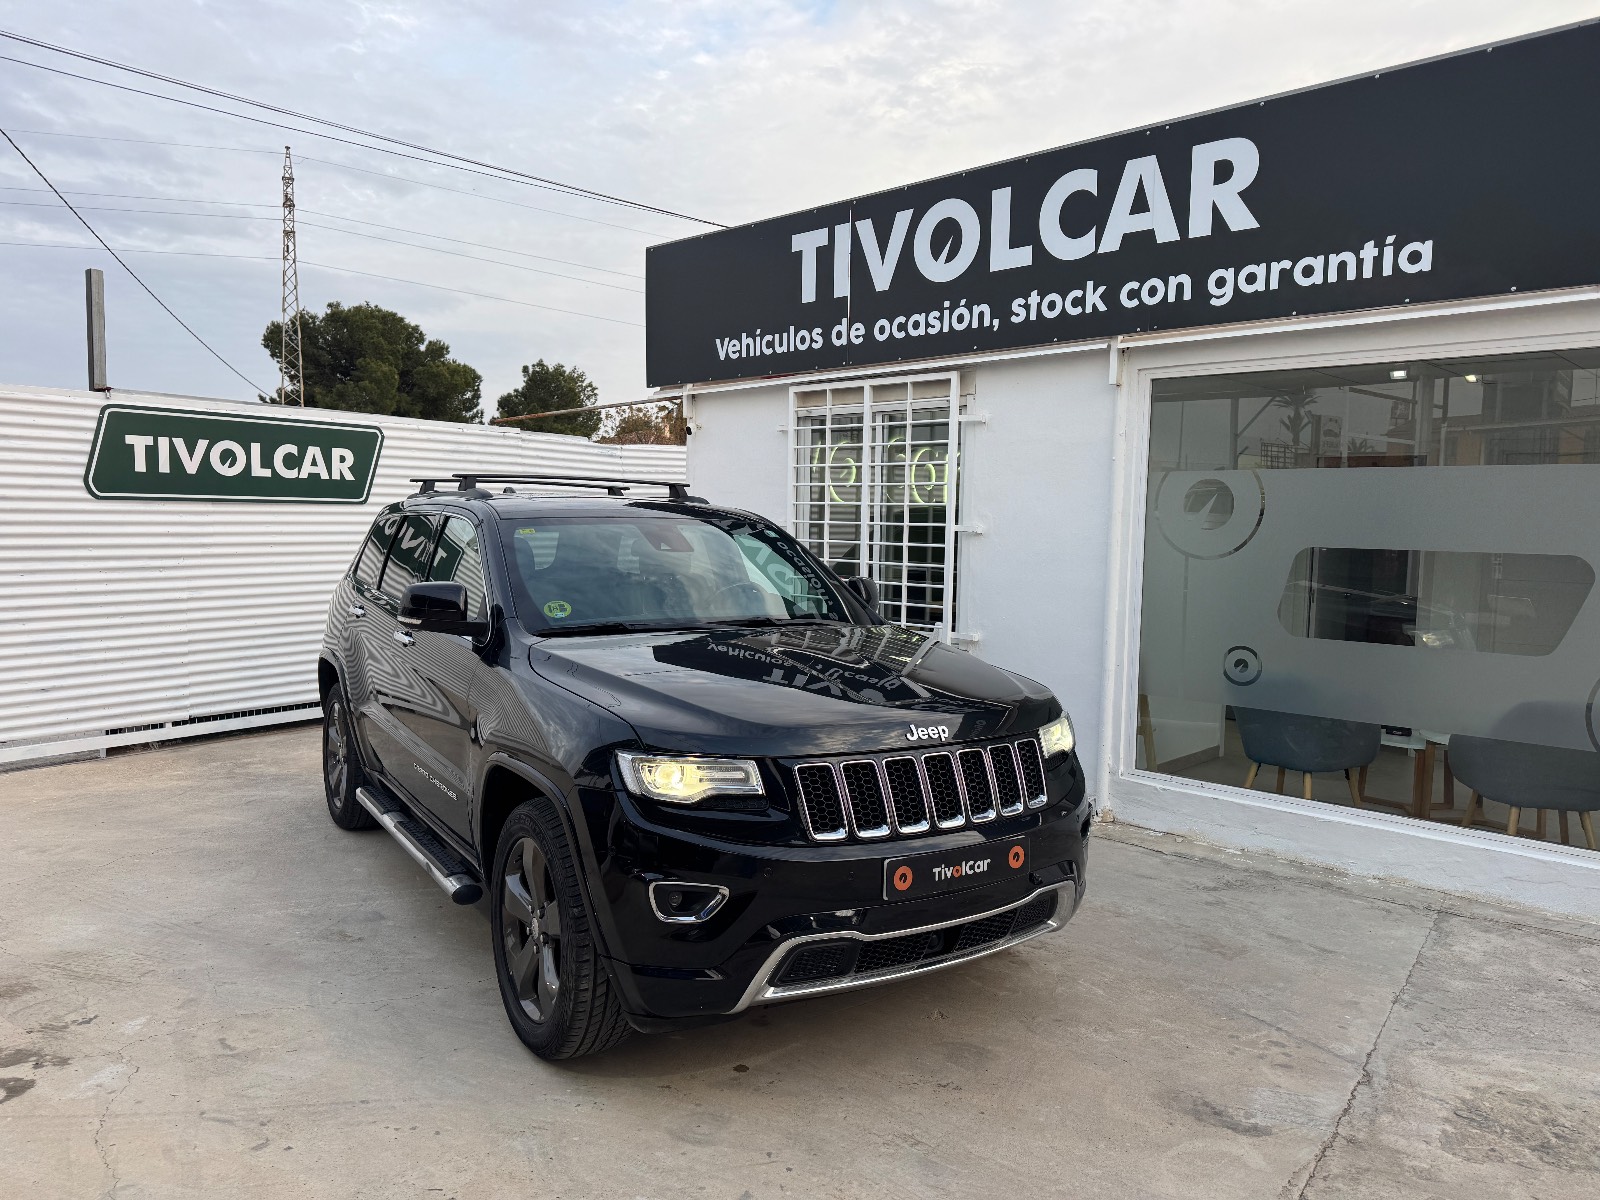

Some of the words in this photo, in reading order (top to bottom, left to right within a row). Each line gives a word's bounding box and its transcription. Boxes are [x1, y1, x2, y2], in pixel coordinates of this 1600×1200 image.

[791, 137, 1261, 304] TIVOLCAR
[715, 326, 824, 361] Vehículos
[831, 317, 866, 347] de
[873, 298, 1000, 342] ocasión,
[1010, 280, 1108, 324] stock
[1119, 273, 1192, 309] con
[1207, 234, 1434, 307] garantía
[124, 434, 356, 481] TIVOLCAR
[905, 724, 949, 742] Jeep
